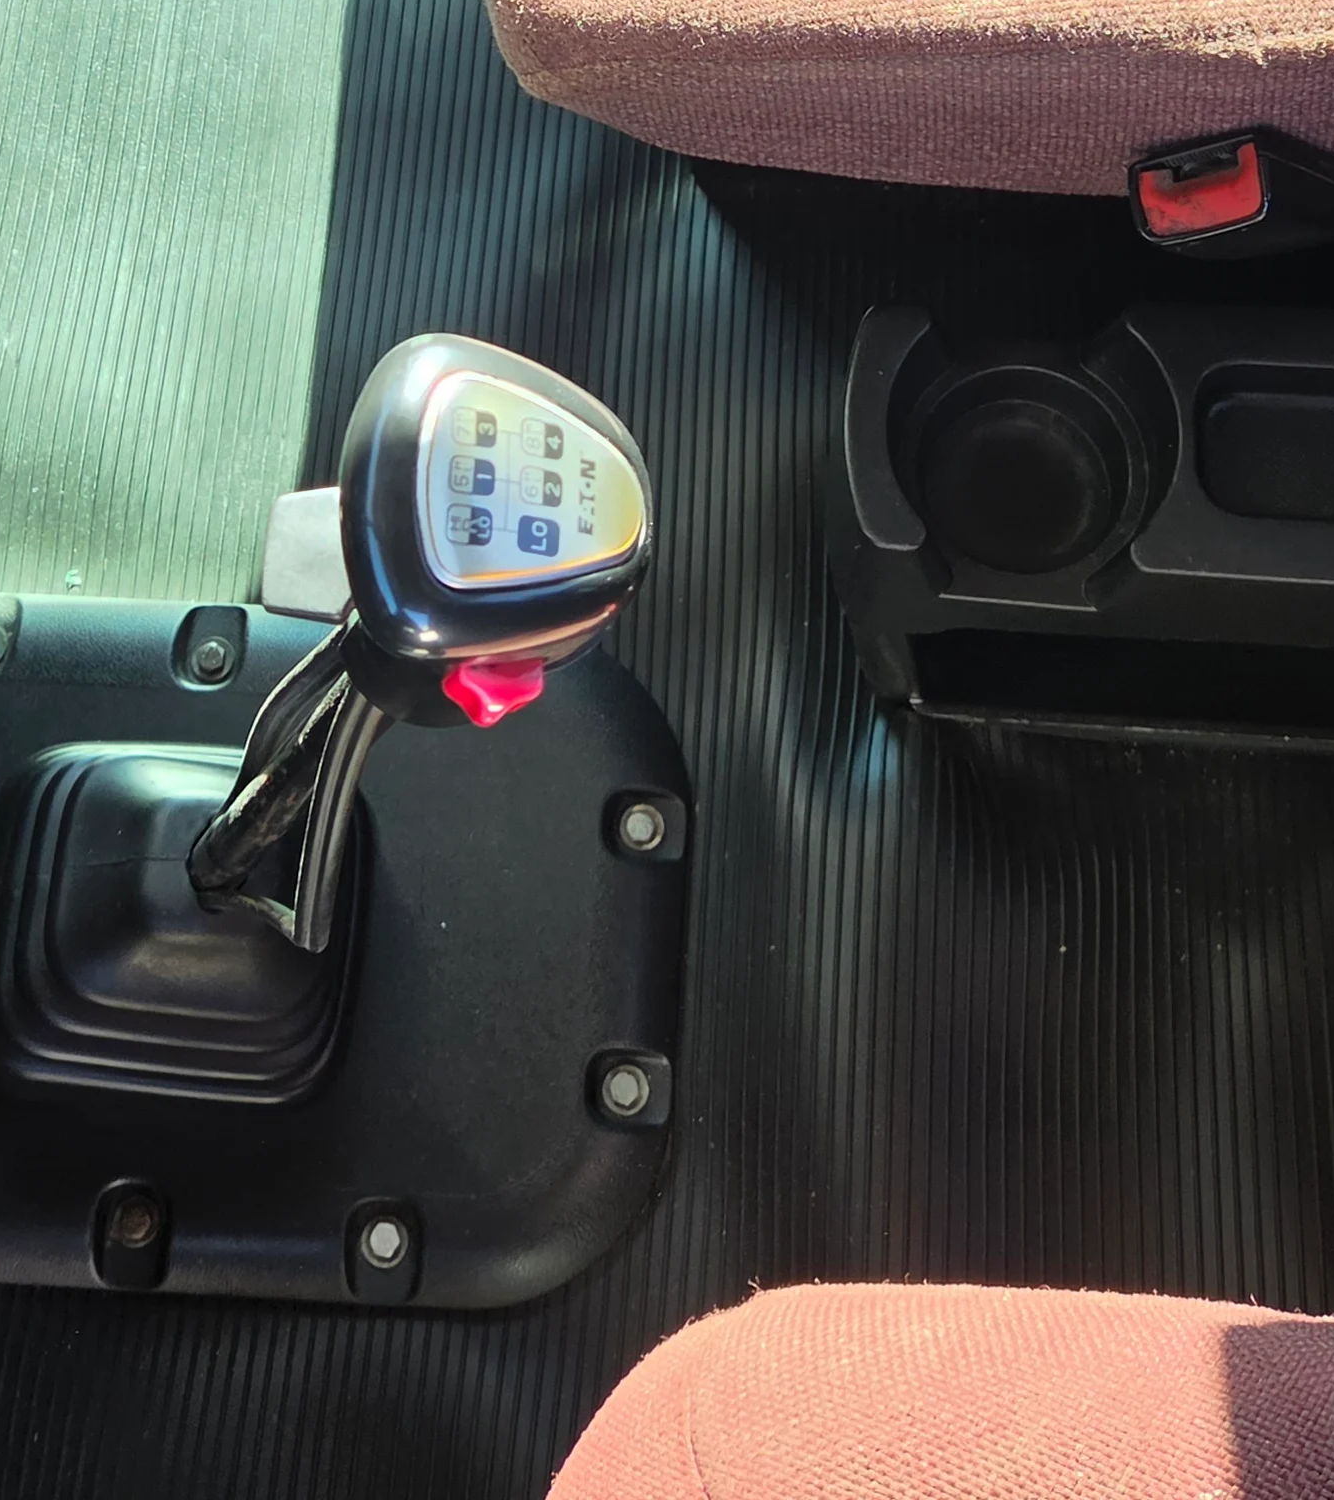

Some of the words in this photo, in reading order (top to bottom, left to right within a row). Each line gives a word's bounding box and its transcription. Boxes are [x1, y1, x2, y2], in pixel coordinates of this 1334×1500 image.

[478, 422, 495, 436] 3
[546, 435, 562, 451] 4
[454, 472, 470, 487] 5
[525, 483, 539, 498] 6
[545, 482, 562, 498] 2
[531, 521, 548, 551] LO
